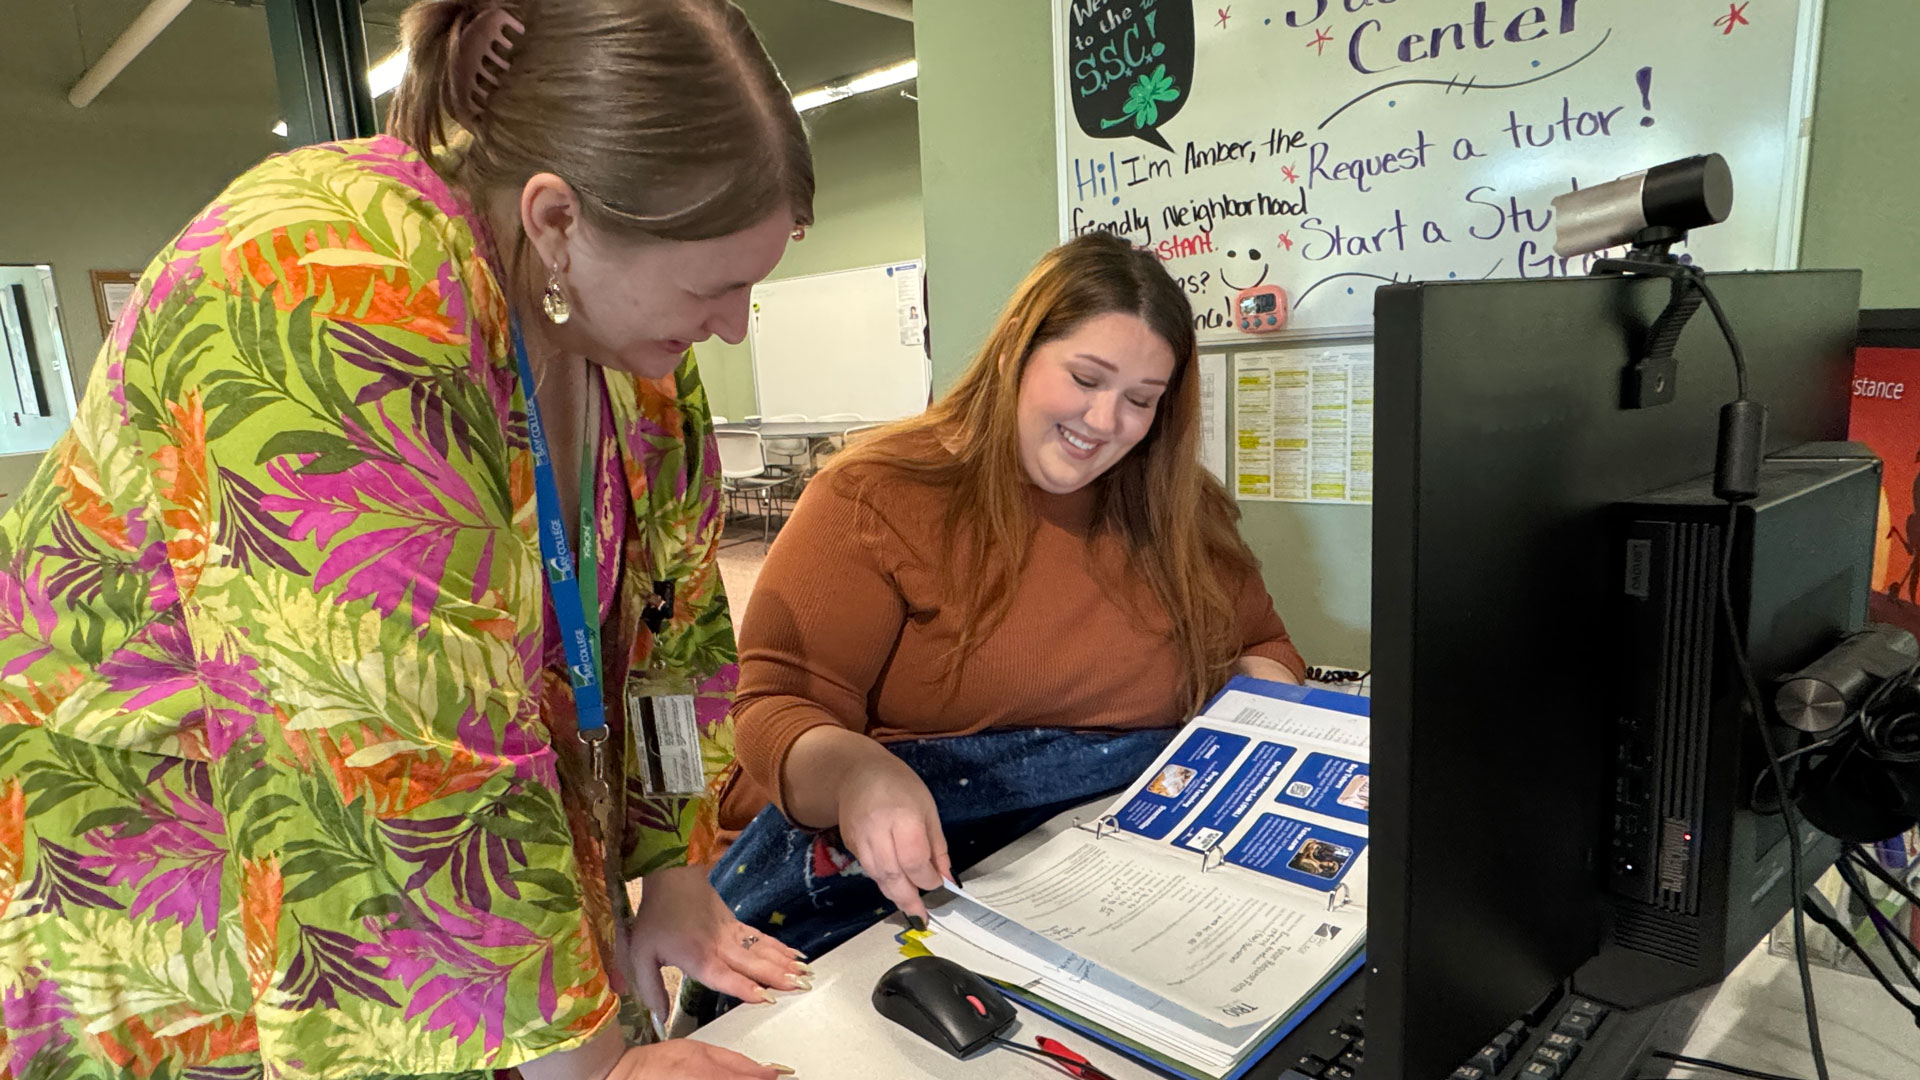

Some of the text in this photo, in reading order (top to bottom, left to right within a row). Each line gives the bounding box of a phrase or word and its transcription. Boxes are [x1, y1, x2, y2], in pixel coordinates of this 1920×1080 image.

[1074, 35, 1094, 50] to
[1100, 7, 1132, 34] the
[1348, 0, 1578, 75] Center
[1075, 128, 1308, 206] Hi! I'm Amber, the
[1308, 130, 1436, 193] Request
[1453, 138, 1487, 161] a
[1300, 209, 1408, 261] Start
[1423, 221, 1452, 243] a
[1852, 376, 1905, 400] stance
[551, 518, 567, 555] COLLEGE
[574, 627, 590, 662] COLLEGE
[1249, 775, 1271, 793] Writing
[1263, 760, 1283, 776] Online
